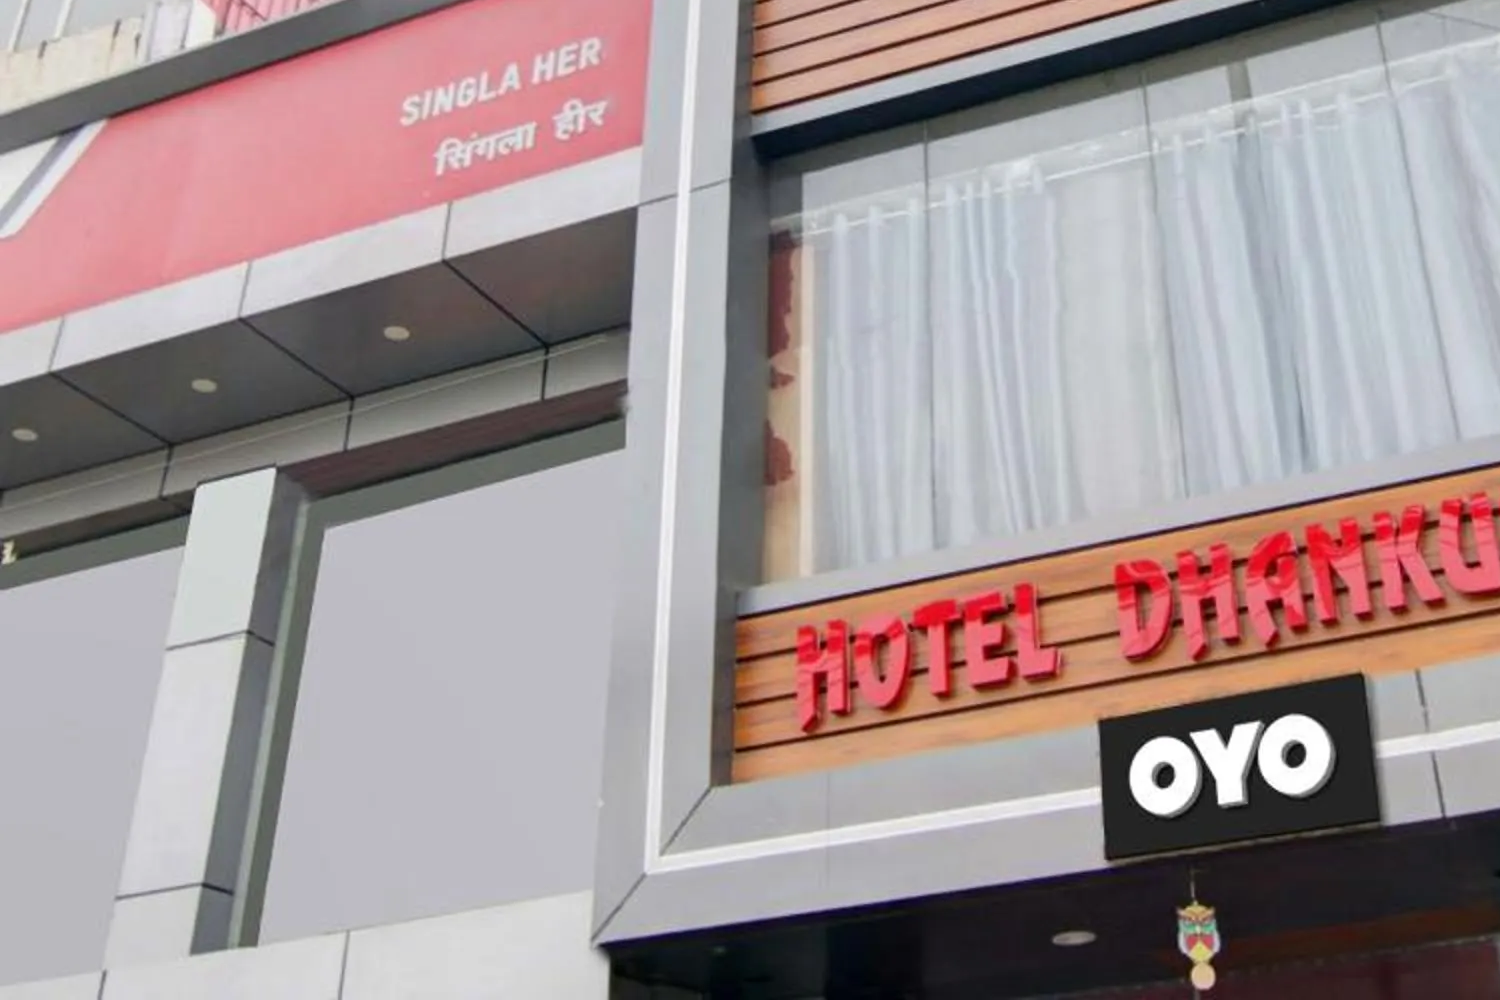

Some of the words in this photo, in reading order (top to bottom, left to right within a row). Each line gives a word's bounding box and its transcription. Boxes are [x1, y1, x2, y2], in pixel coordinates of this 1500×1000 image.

[400, 61, 522, 126] SINGLA
[531, 37, 602, 84] HER
[432, 121, 538, 176] सिंगला
[552, 98, 607, 141] हीर
[796, 581, 1064, 733] HOTEL
[1128, 713, 1336, 818] OYO
